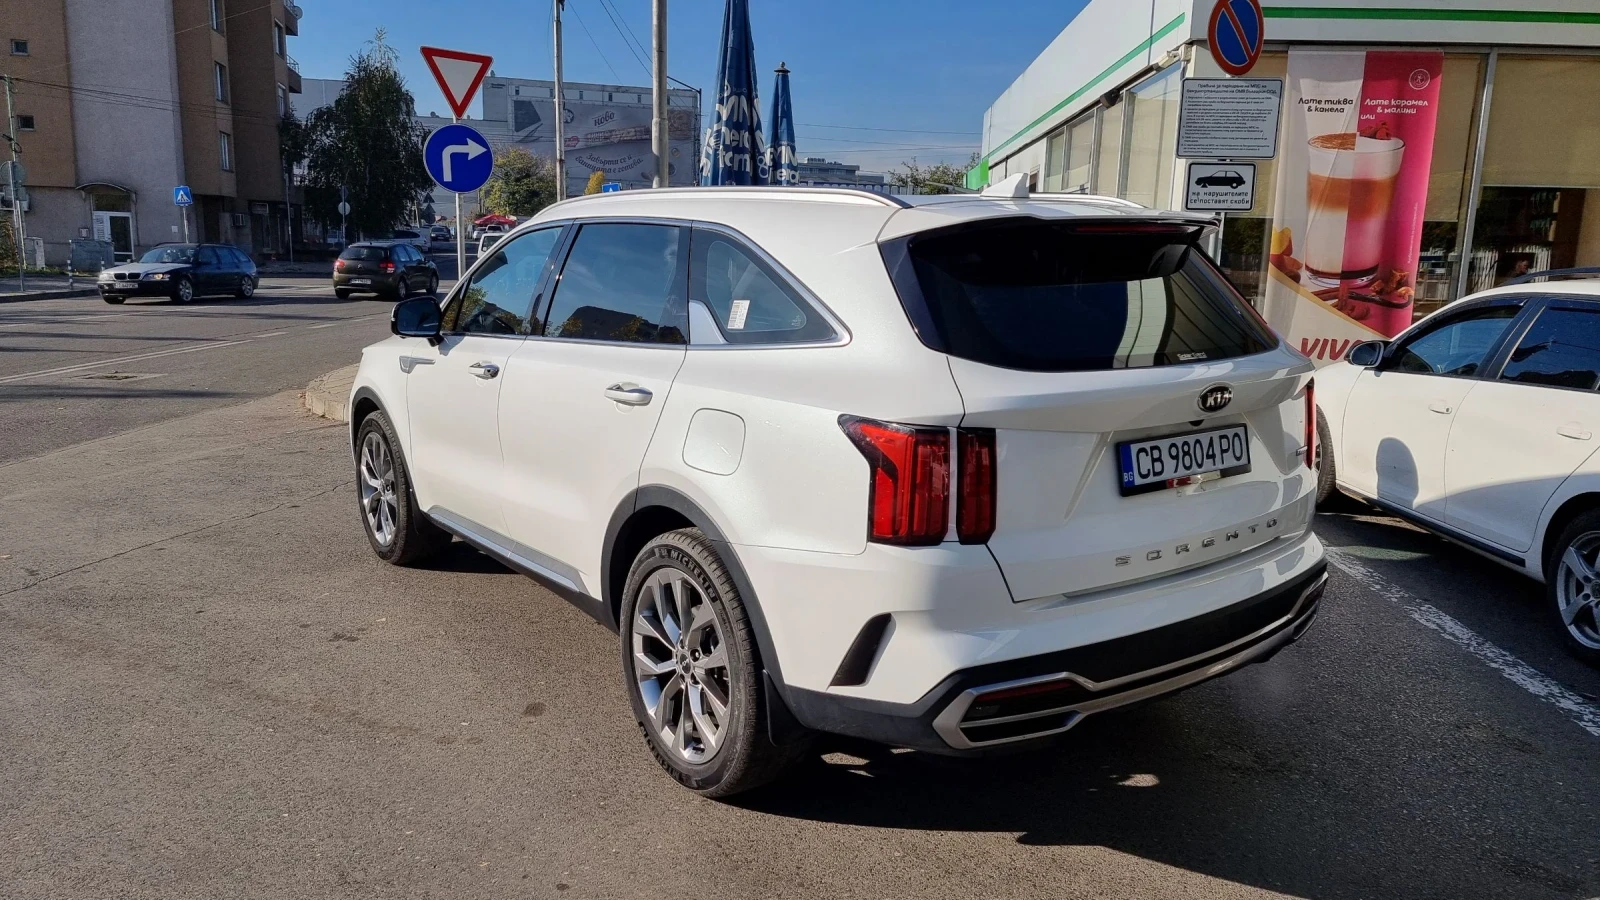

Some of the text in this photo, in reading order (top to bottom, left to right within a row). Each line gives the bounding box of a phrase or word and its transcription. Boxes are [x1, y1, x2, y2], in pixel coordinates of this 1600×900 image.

[1298, 97, 1354, 106] Лате тиква
[1364, 98, 1390, 106] Лате
[1307, 105, 1345, 114] & канела
[1384, 106, 1418, 114] малини
[594, 111, 615, 126] ново
[586, 152, 620, 167] Завърти
[1230, 197, 1250, 205] скоби
[1301, 338, 1364, 361] VIV
[1136, 432, 1244, 480] CB 9804 PO
[1123, 471, 1134, 482] BG
[1115, 517, 1278, 567] SORENTO
[670, 549, 716, 602] MICHELIN
